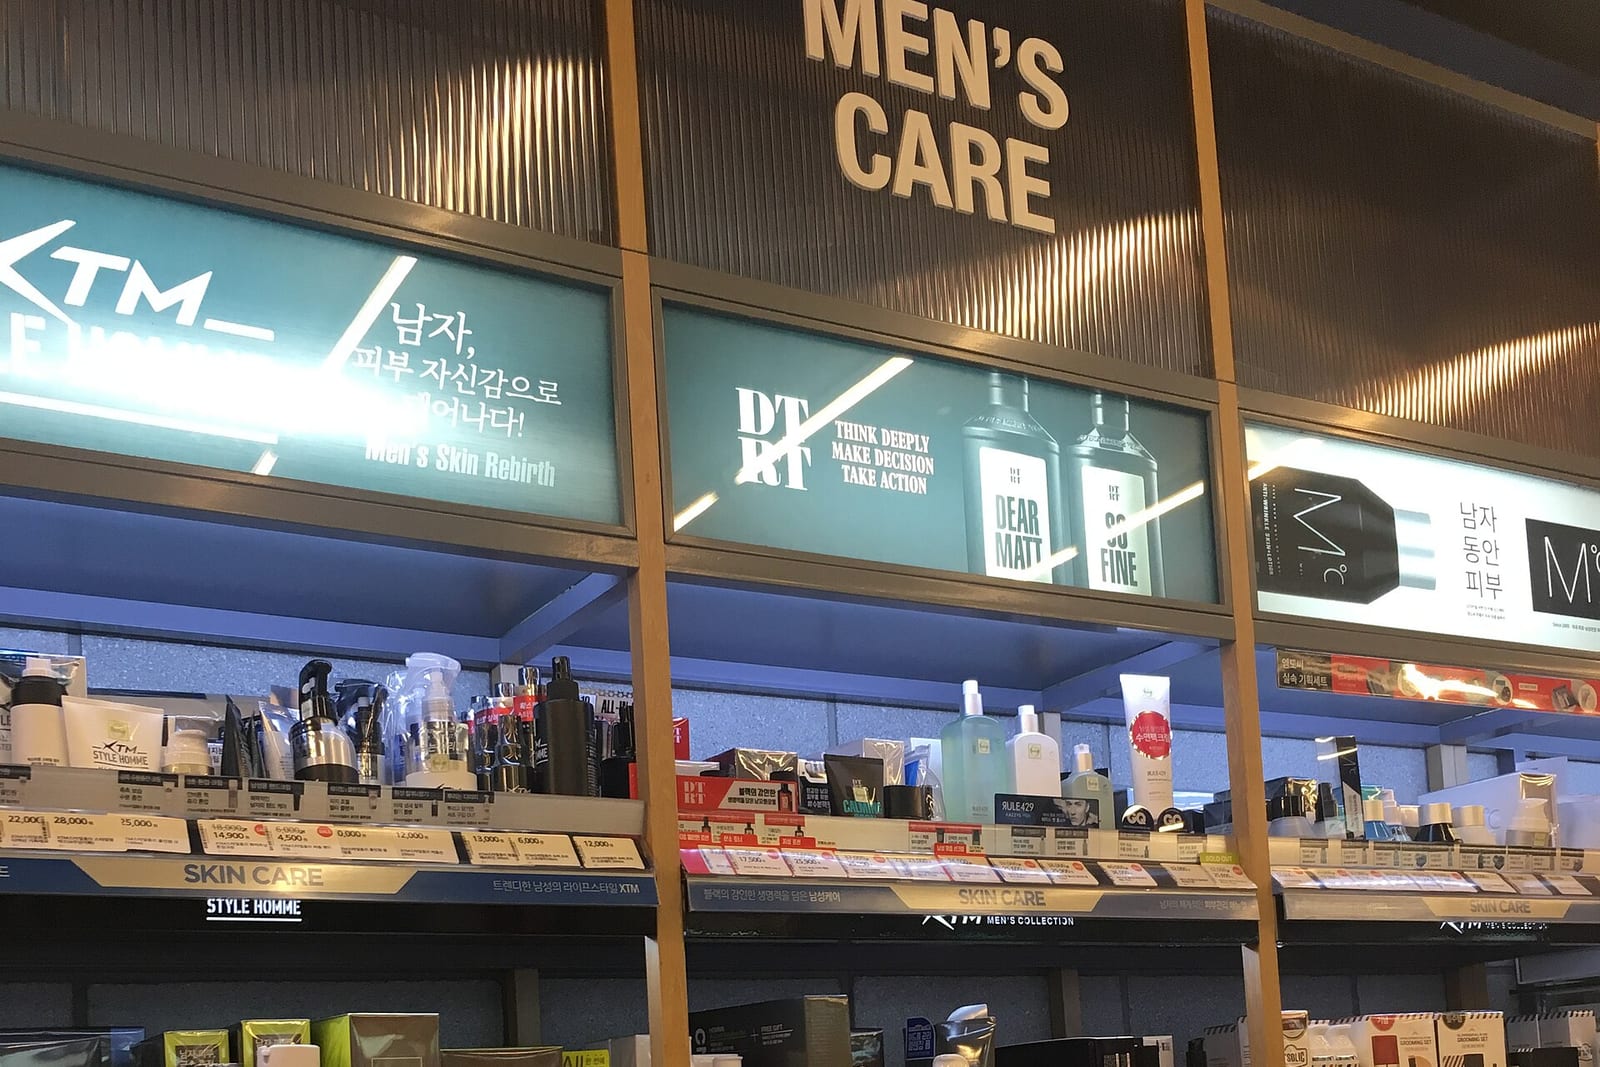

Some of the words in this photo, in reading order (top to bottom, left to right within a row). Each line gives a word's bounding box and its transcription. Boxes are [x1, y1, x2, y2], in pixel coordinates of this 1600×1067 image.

[803, 0, 1070, 130] MEN'S
[834, 91, 1056, 235] CARE
[391, 302, 476, 360] 남자,
[352, 345, 415, 383] 피부
[419, 357, 562, 406] 자신감으로
[835, 420, 878, 445] THINK
[880, 428, 931, 454] DEEPLY
[365, 441, 430, 468] Men's
[436, 443, 478, 476] Skin
[485, 451, 555, 488] Rebirth
[831, 441, 872, 465] MAKE
[874, 448, 935, 475] DECISION
[841, 464, 877, 488] TAKE
[880, 472, 928, 495] ACTION
[995, 494, 1041, 536] DEAR
[1459, 501, 1498, 534] 남자
[1105, 511, 1129, 550] SO
[994, 532, 1043, 571] MATT
[1462, 536, 1500, 567] 동안
[1100, 547, 1139, 588] FINE
[1465, 571, 1504, 601] 피부
[1281, 672, 1298, 685] 실속
[1298, 673, 1329, 687] 기획세트
[92, 750, 117, 763] STYLE
[118, 754, 149, 766] HOMME
[102, 740, 138, 757] XTM
[54, 816, 88, 826] 28,000
[213, 831, 245, 840] 14,900
[277, 833, 303, 842] 4,500
[473, 834, 500, 844] 13,000
[517, 836, 540, 846] 6,000
[583, 840, 610, 849] 12,000
[184, 863, 246, 885] SKIN
[252, 865, 324, 887] CARE
[492, 880, 532, 893] 트렌디한
[533, 881, 563, 893] 남성의
[563, 882, 618, 894] 라이프스타일
[619, 883, 641, 894] XTM
[206, 898, 250, 915] STYLE
[253, 899, 302, 916] HOMME
[959, 889, 998, 905] SKIN
[1000, 891, 1047, 907] CARE
[1470, 900, 1497, 913] SKIN
[1500, 901, 1532, 914] CARE
[987, 915, 1016, 926] MEN'S
[1017, 916, 1075, 927] COLLECTION
